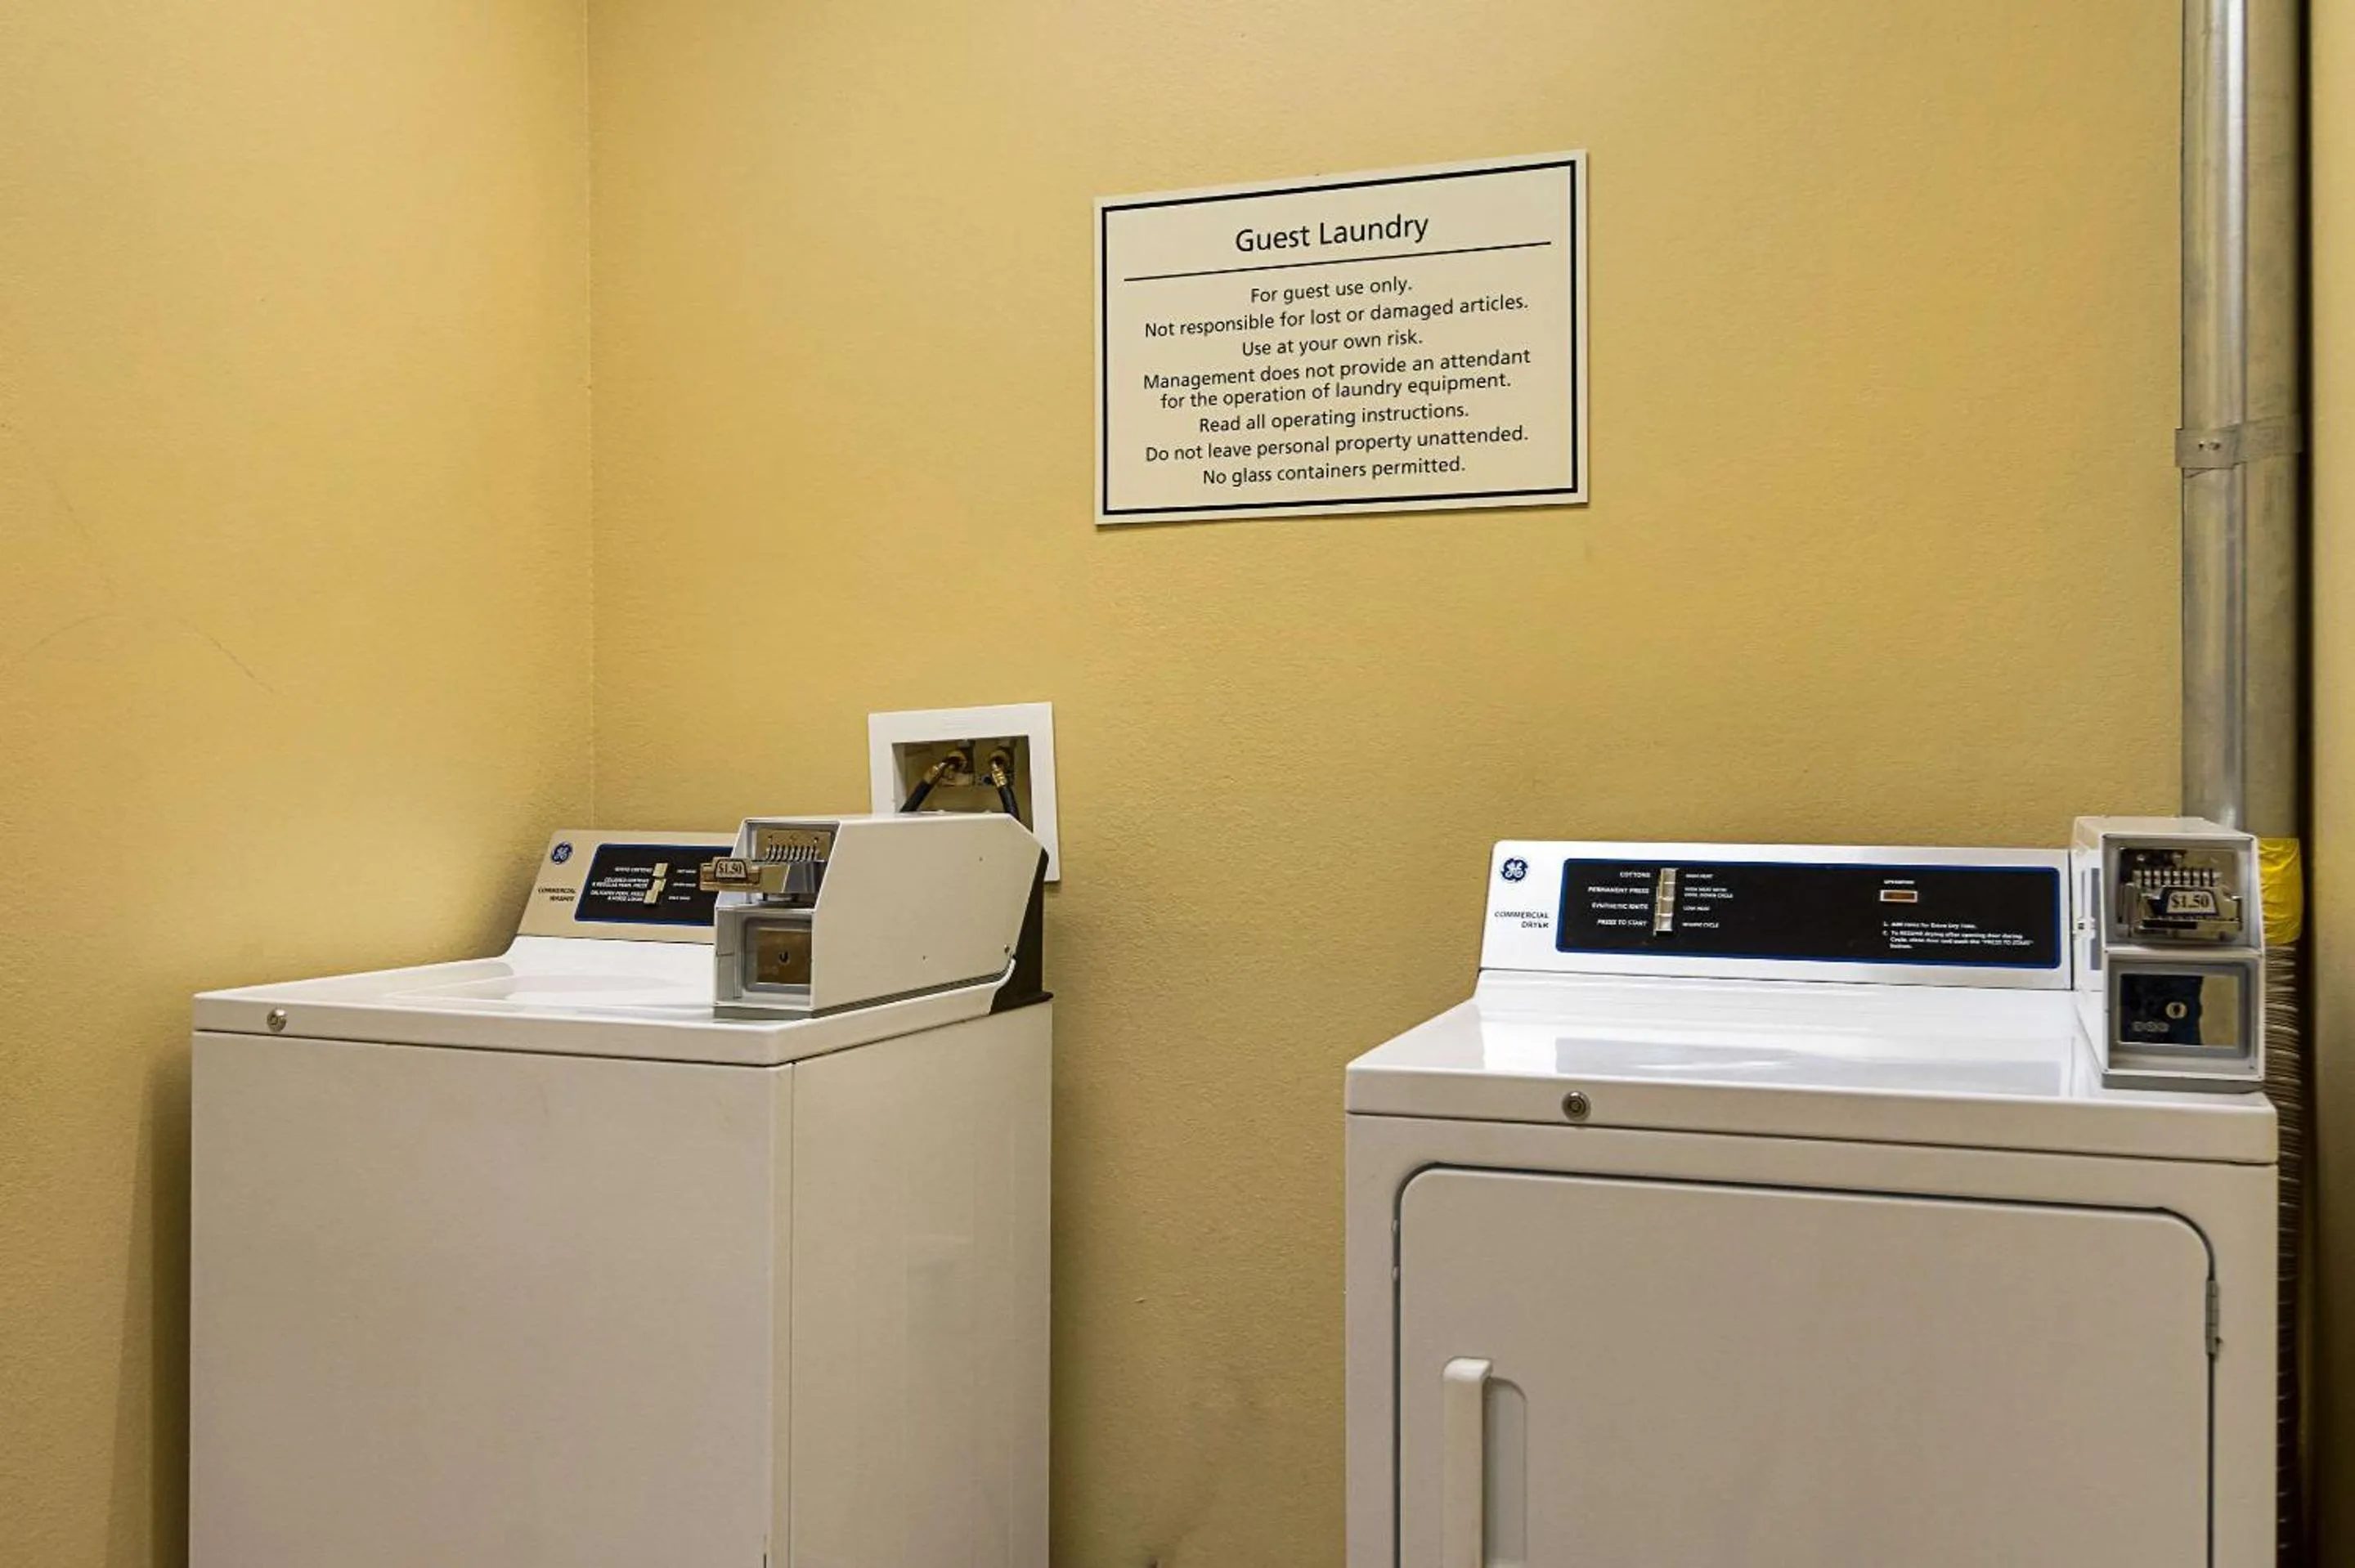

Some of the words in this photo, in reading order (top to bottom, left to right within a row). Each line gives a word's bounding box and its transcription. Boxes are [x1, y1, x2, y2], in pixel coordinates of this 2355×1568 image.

[1235, 225, 1311, 253] Guest
[1320, 213, 1429, 245] Laundry
[1251, 288, 1278, 303] For
[1283, 283, 1330, 306] guest
[1335, 283, 1364, 296] use
[1370, 276, 1412, 296] only.
[1145, 322, 1175, 338] Not
[1180, 313, 1275, 337] responsible
[1279, 311, 1306, 328] for
[1310, 309, 1342, 325] lost
[1346, 309, 1365, 323] or
[1370, 298, 1454, 321] damaged
[1459, 293, 1528, 314] articles.
[1242, 341, 1272, 356] Use
[1276, 339, 1294, 354] at
[1299, 338, 1339, 357] your
[1343, 335, 1381, 350] own
[1387, 329, 1423, 346] risk.
[1143, 369, 1255, 391] Management
[1260, 365, 1300, 383] does
[1305, 363, 1335, 379] not
[1340, 356, 1406, 380] provide
[1412, 358, 1434, 372] an
[1440, 349, 1532, 370] attendant
[1160, 393, 1185, 410] for
[1190, 392, 1218, 408] the
[1222, 386, 1306, 409] operation
[1312, 382, 1331, 400] of
[1335, 379, 1402, 398] laundry
[1407, 373, 1511, 396] equipment.
[1200, 414, 1240, 432] Read
[1245, 414, 1266, 430] all
[1271, 409, 1356, 432] operating
[1361, 403, 1469, 423] instructions.
[1146, 446, 1169, 462] Do
[1174, 445, 1204, 460] not
[1208, 442, 1252, 459] leave
[1257, 435, 1330, 459] personal
[1335, 434, 1412, 455] property
[1417, 424, 1528, 447] unattended.
[1203, 469, 1227, 485] No
[1231, 467, 1272, 487] glass
[1276, 462, 1367, 482] containers
[1371, 455, 1465, 480] permitted.
[1494, 911, 1550, 919] COMMERCIAL
[2171, 894, 2209, 908] $1.50
[1521, 921, 1550, 929] DRYER
